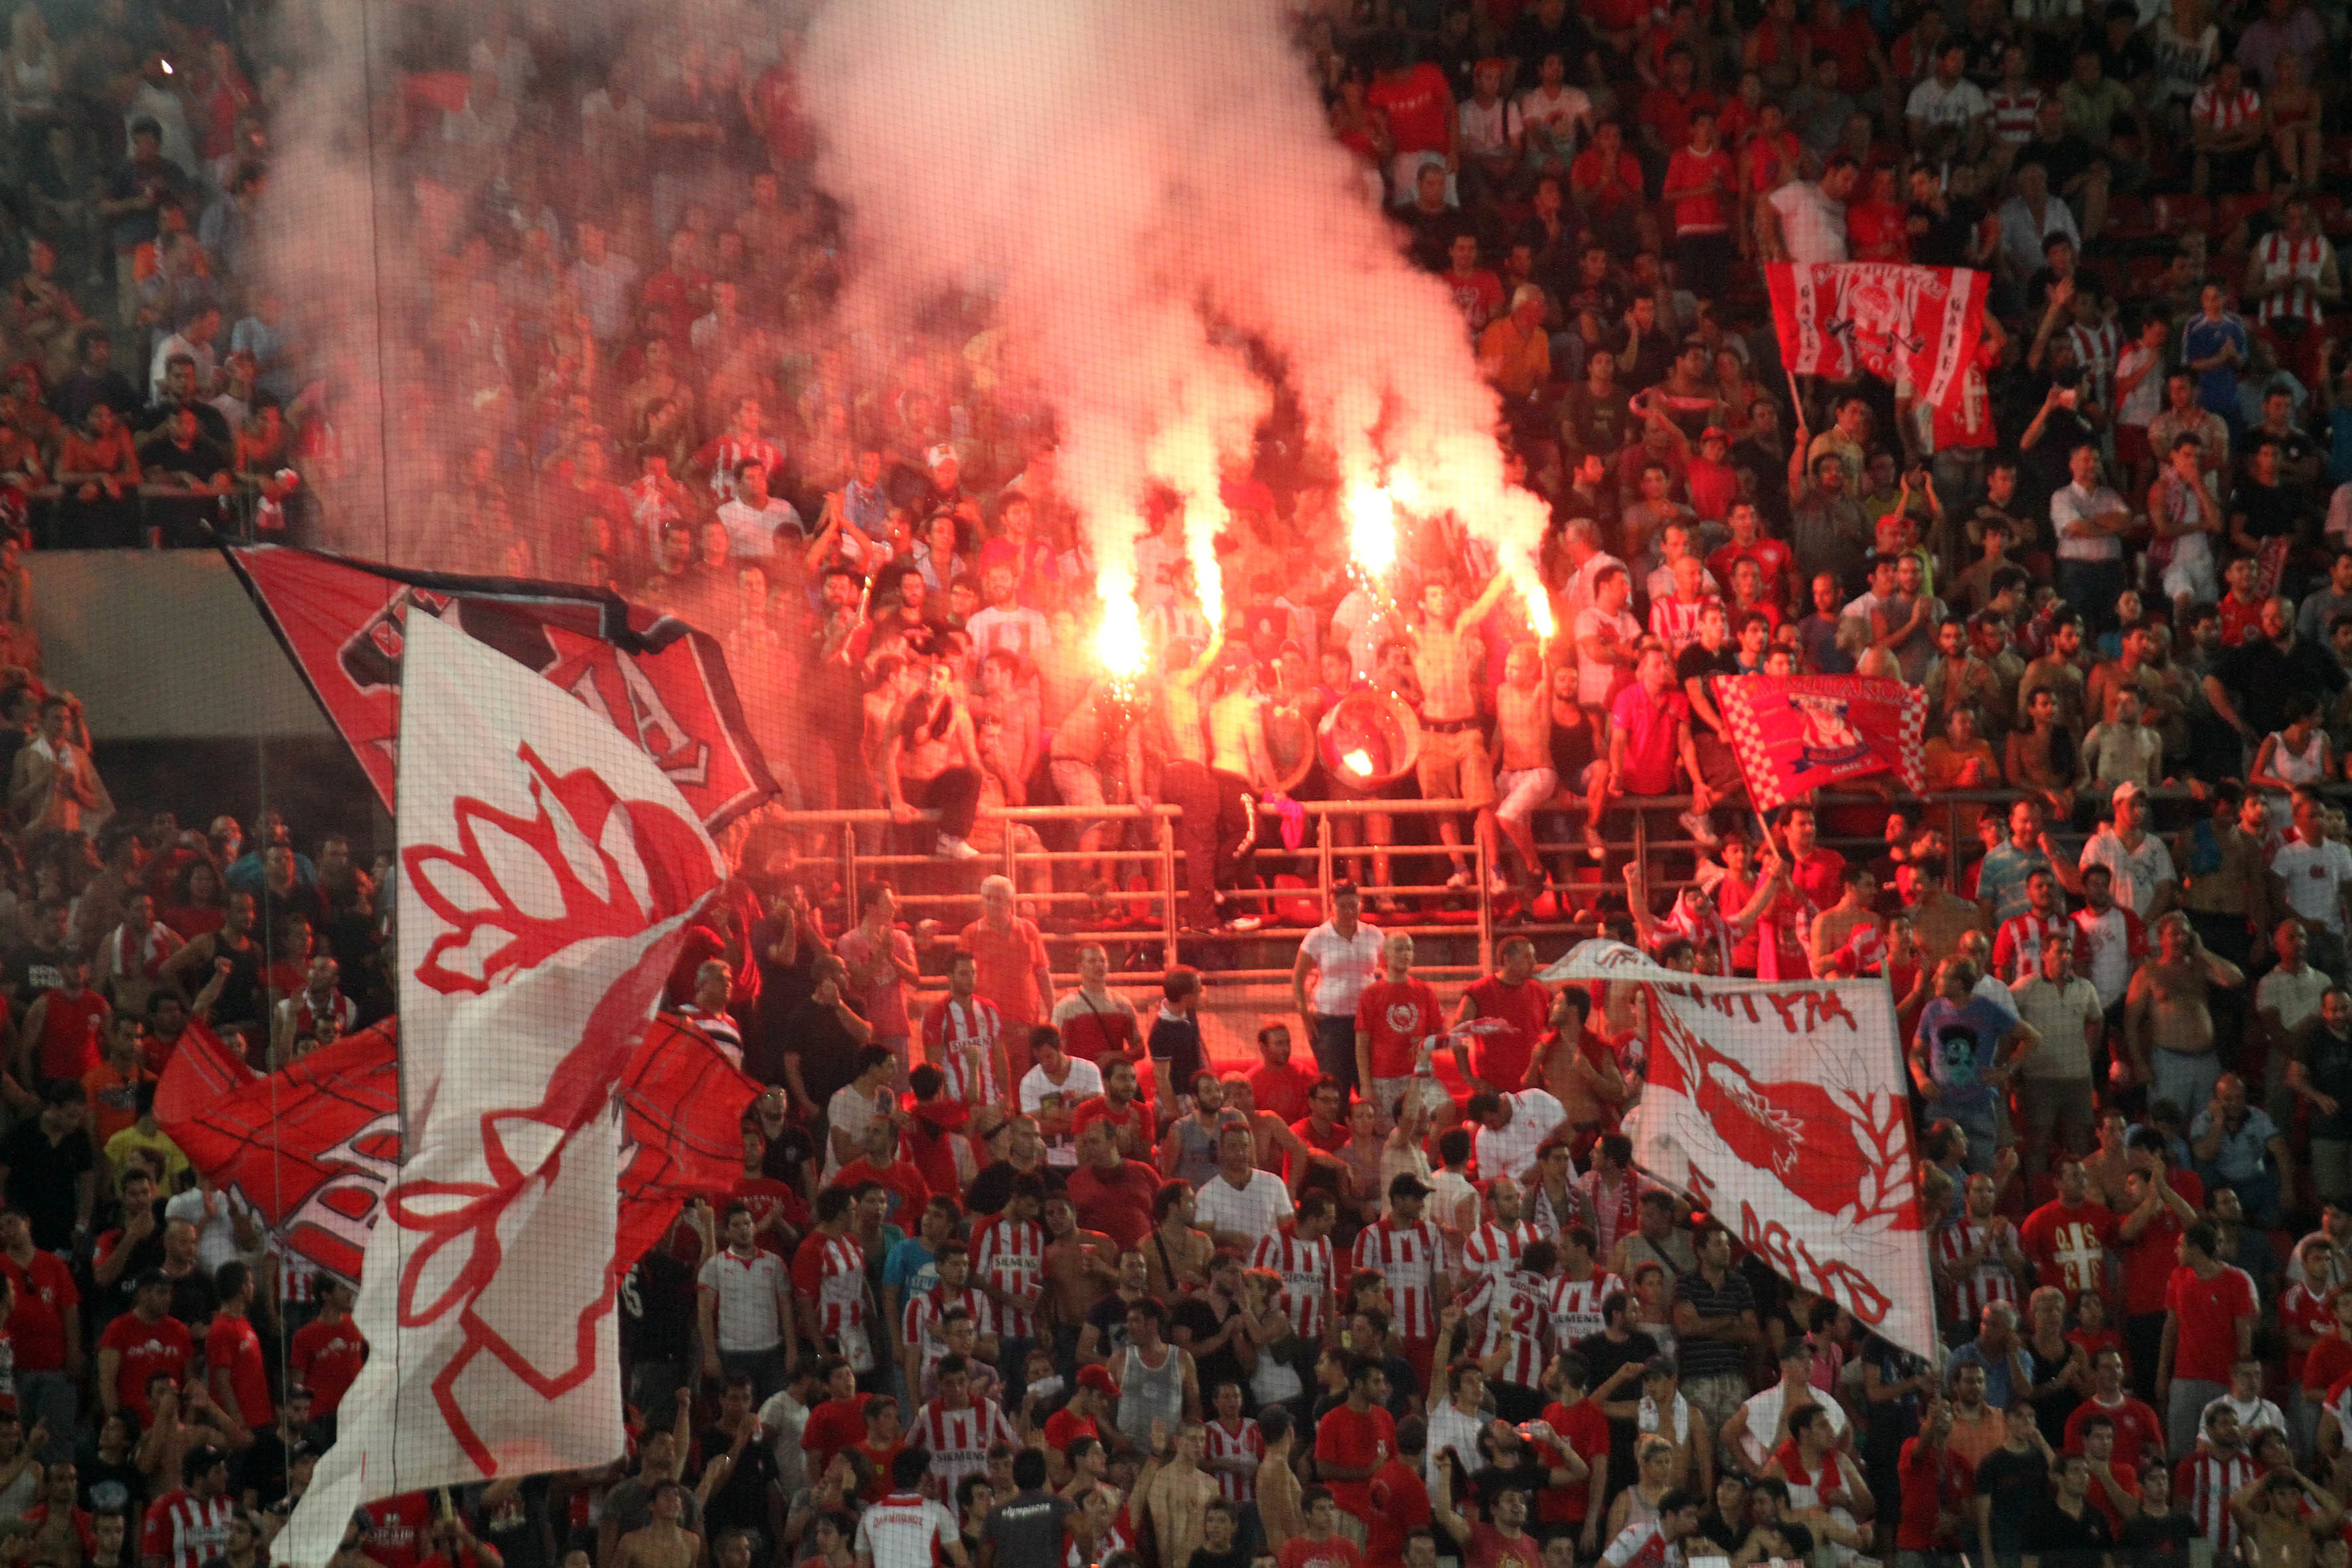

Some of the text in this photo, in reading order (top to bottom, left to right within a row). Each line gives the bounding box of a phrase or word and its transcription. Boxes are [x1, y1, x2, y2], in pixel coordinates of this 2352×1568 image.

[1942, 299, 1960, 370] GATE
[996, 1256, 1037, 1269] SIEMENS
[1282, 1272, 1321, 1283] SIEMEN
[936, 1450, 986, 1462] SIEMENS
[1002, 1502, 1052, 1519] olympiacos
